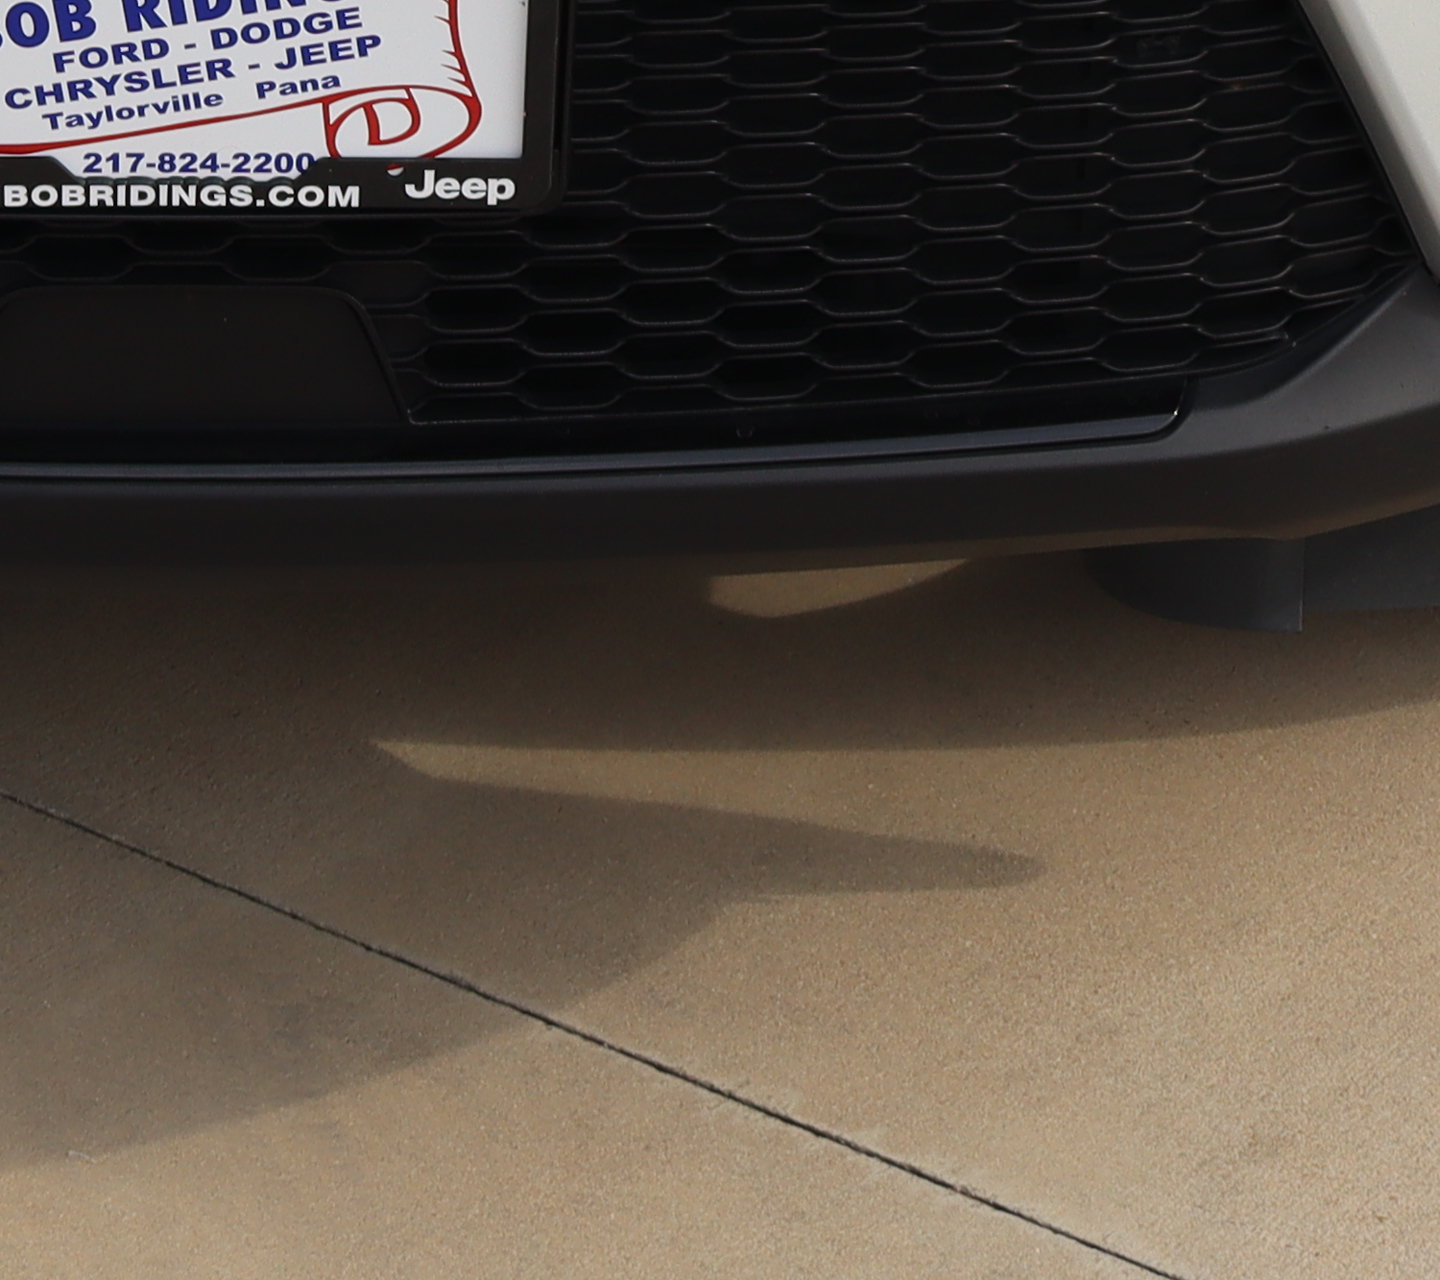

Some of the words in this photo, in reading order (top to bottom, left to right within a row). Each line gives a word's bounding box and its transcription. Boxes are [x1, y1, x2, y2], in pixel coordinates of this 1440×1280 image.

[53, 37, 170, 74] FORD
[210, 6, 363, 50] DODGE
[4, 57, 236, 110] CHRYSLER
[274, 34, 382, 71] JEEP
[42, 93, 224, 131] Taylorville
[255, 73, 341, 100] Pana
[82, 152, 316, 174] 217-824-2200
[3, 184, 361, 208] BOBRIDINGS.COM
[405, 169, 516, 206] Jeep
